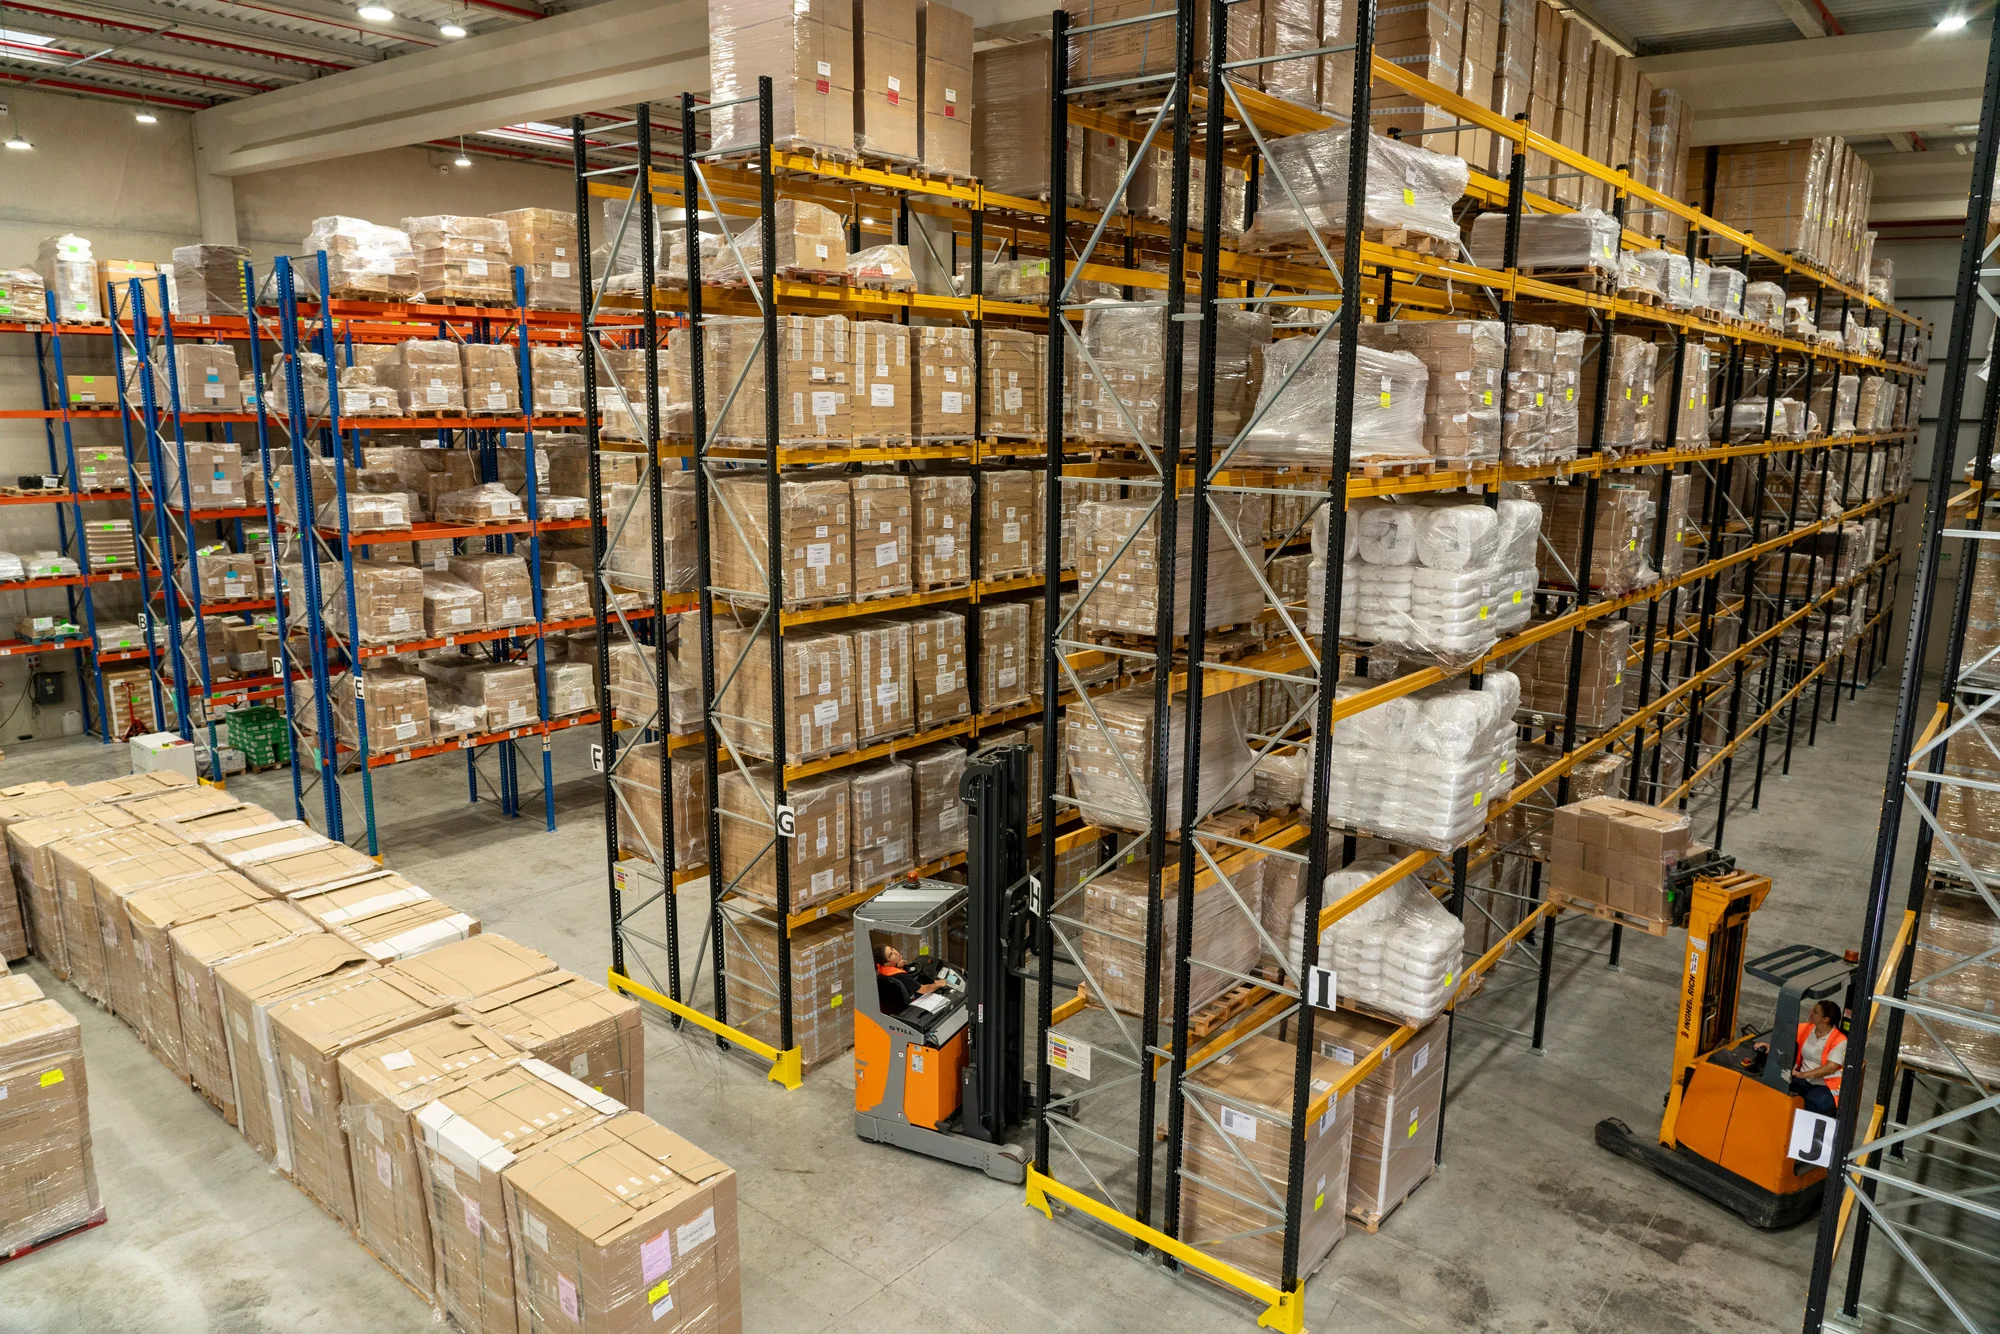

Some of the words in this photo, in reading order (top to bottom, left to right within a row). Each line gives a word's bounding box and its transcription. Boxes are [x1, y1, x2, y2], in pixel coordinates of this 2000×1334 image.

[140, 614, 147, 630] B
[274, 659, 283, 675] D
[355, 679, 364, 698] E
[592, 747, 604, 770] F
[778, 810, 795, 835] G
[1031, 881, 1040, 913] H
[1315, 969, 1331, 1009] I
[888, 1025, 914, 1035] STILL
[1798, 1118, 1827, 1162] J
